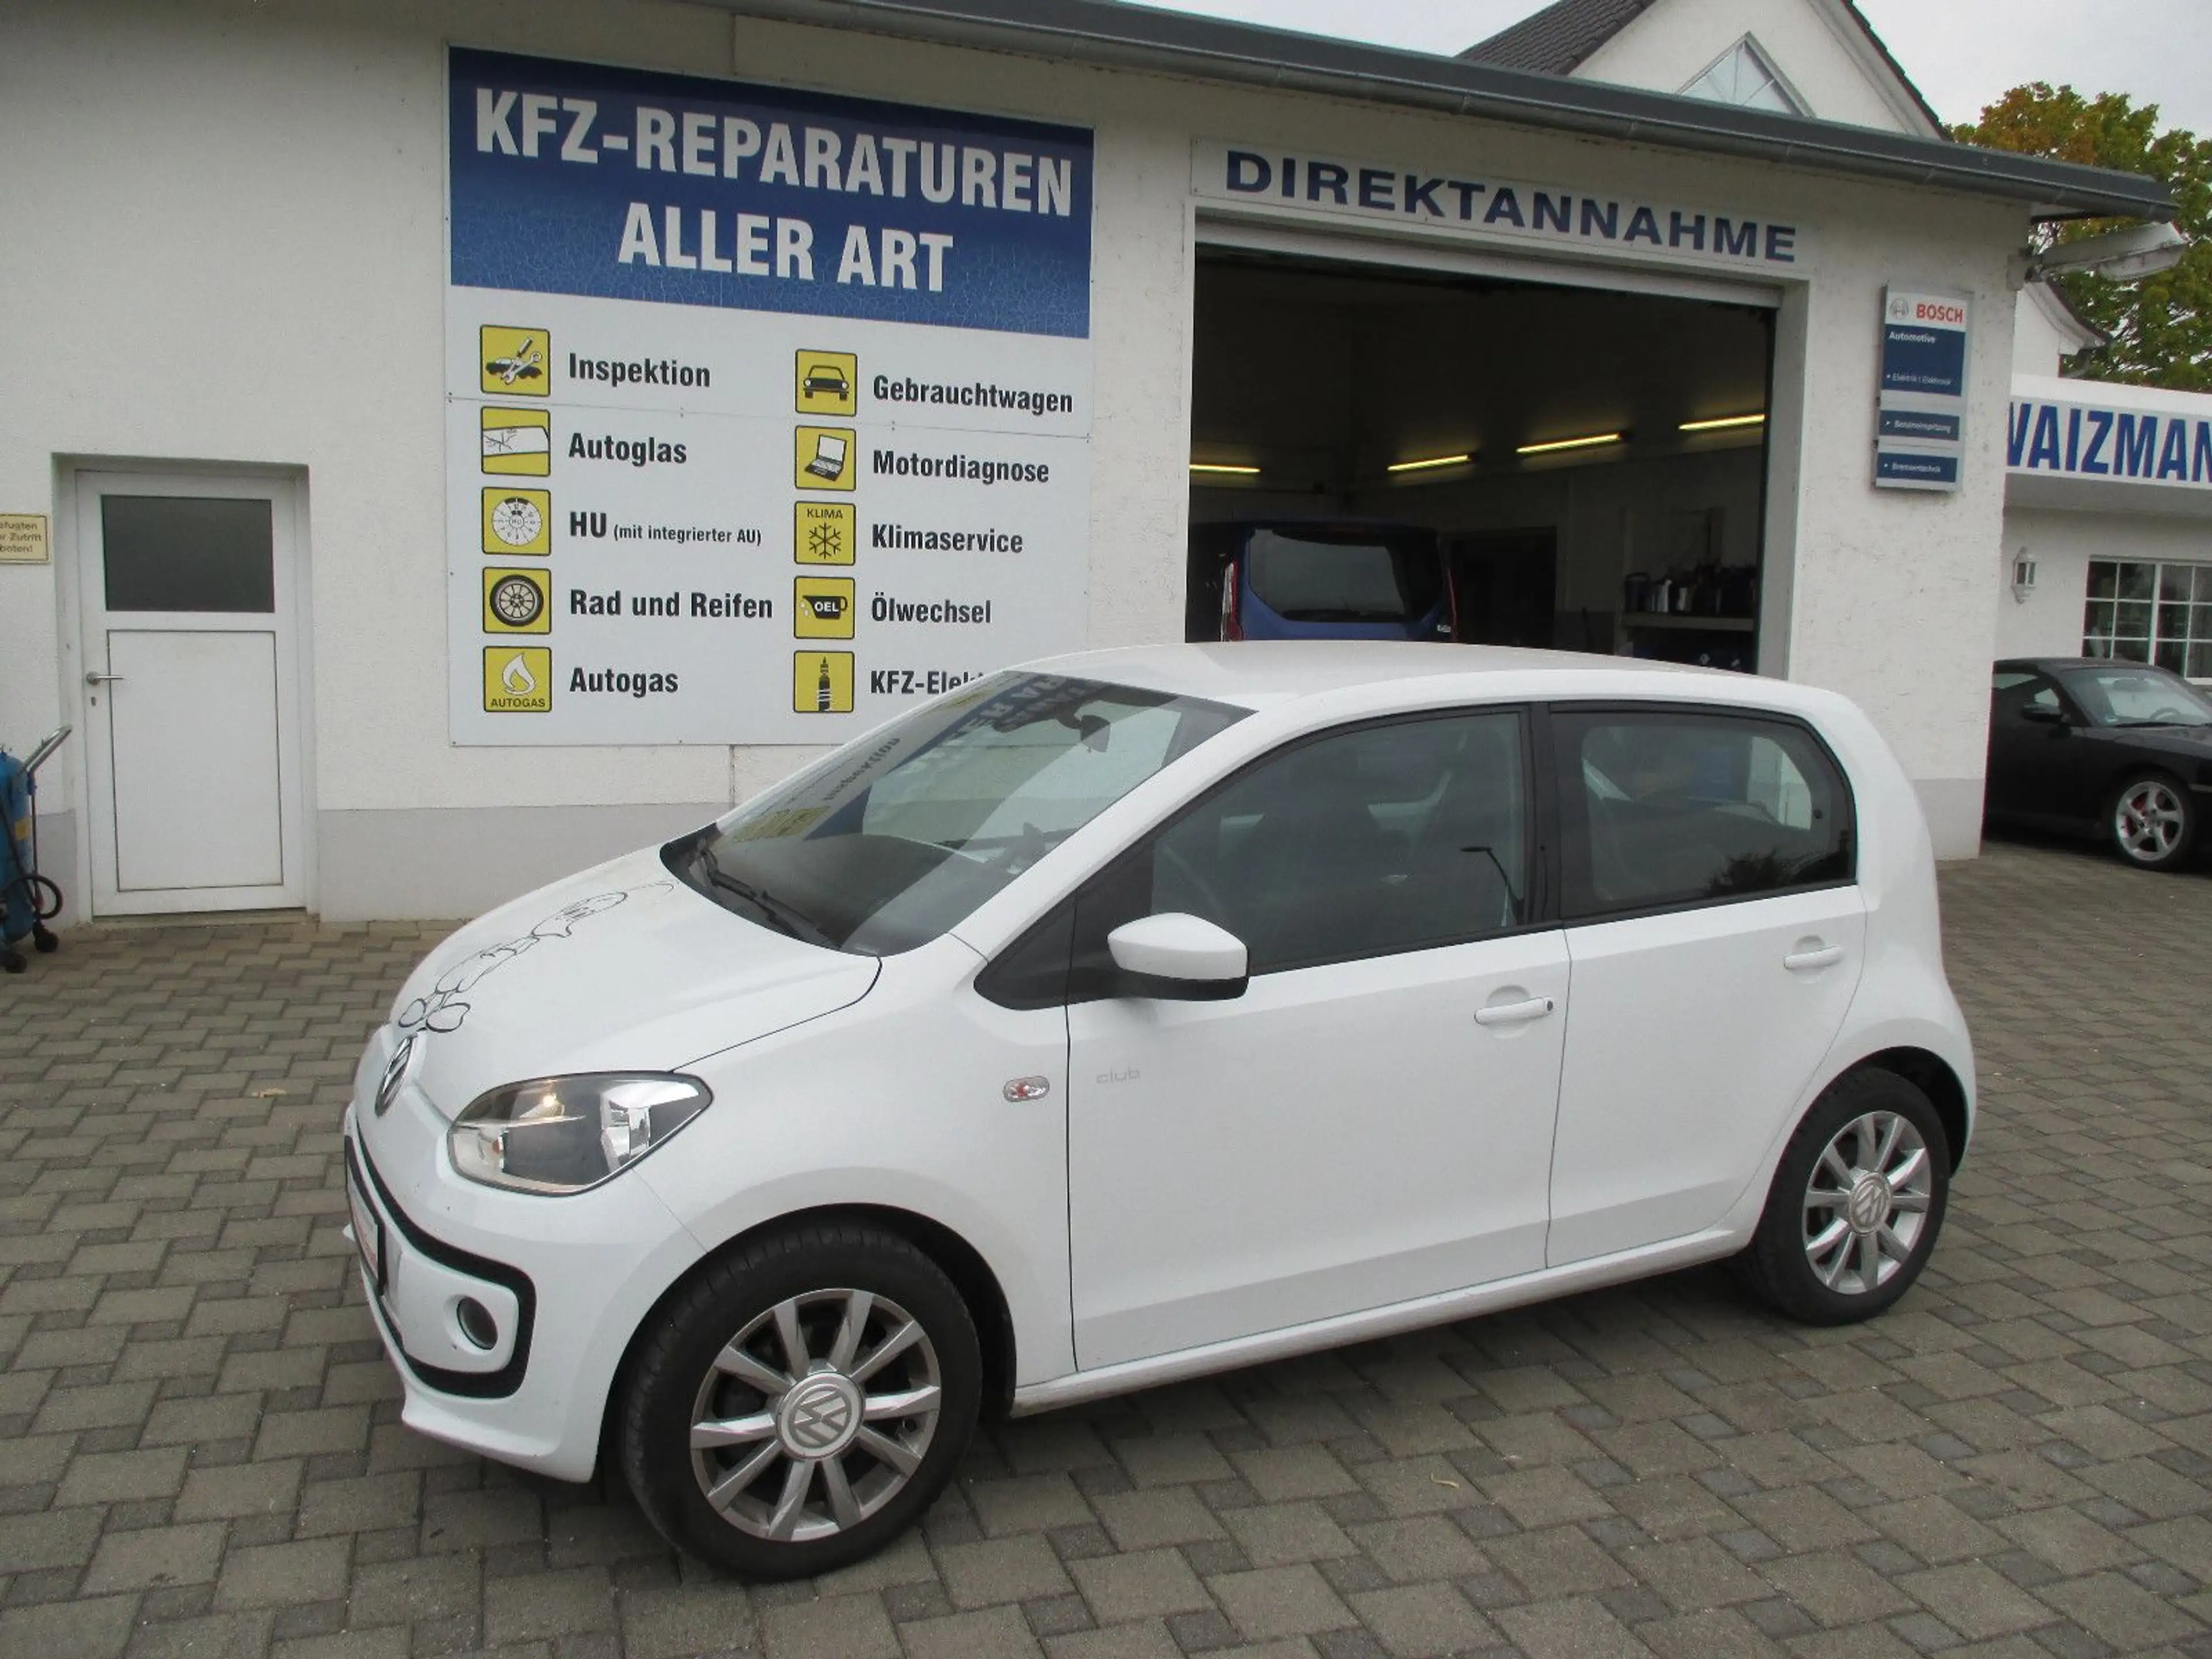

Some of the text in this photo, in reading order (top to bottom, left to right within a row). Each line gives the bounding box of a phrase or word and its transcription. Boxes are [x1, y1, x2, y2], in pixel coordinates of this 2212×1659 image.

[476, 86, 1072, 217] KFZ-REPARATUREN
[1225, 150, 1796, 263] DIREKTANNAHME
[618, 202, 955, 293] ALLER ART
[1916, 304, 1963, 323] BOSCH
[1889, 331, 1936, 344] Automotive
[569, 353, 710, 387] Inspektion
[873, 374, 1073, 416] Gebrauchtwagen
[569, 432, 687, 467] Autoglas
[873, 449, 1050, 485] Motordiagnose
[570, 511, 762, 546] HU (mit integrierter AU)
[807, 508, 843, 520] KLIMA
[872, 523, 1024, 554] Klimaservice
[570, 589, 773, 618] Rad und Reifen
[814, 601, 839, 612] OEL
[872, 592, 991, 623] Ölwechsel
[569, 667, 679, 698] Autogas
[490, 698, 546, 708] AUTOGAS
[1096, 1067, 1140, 1084] club
